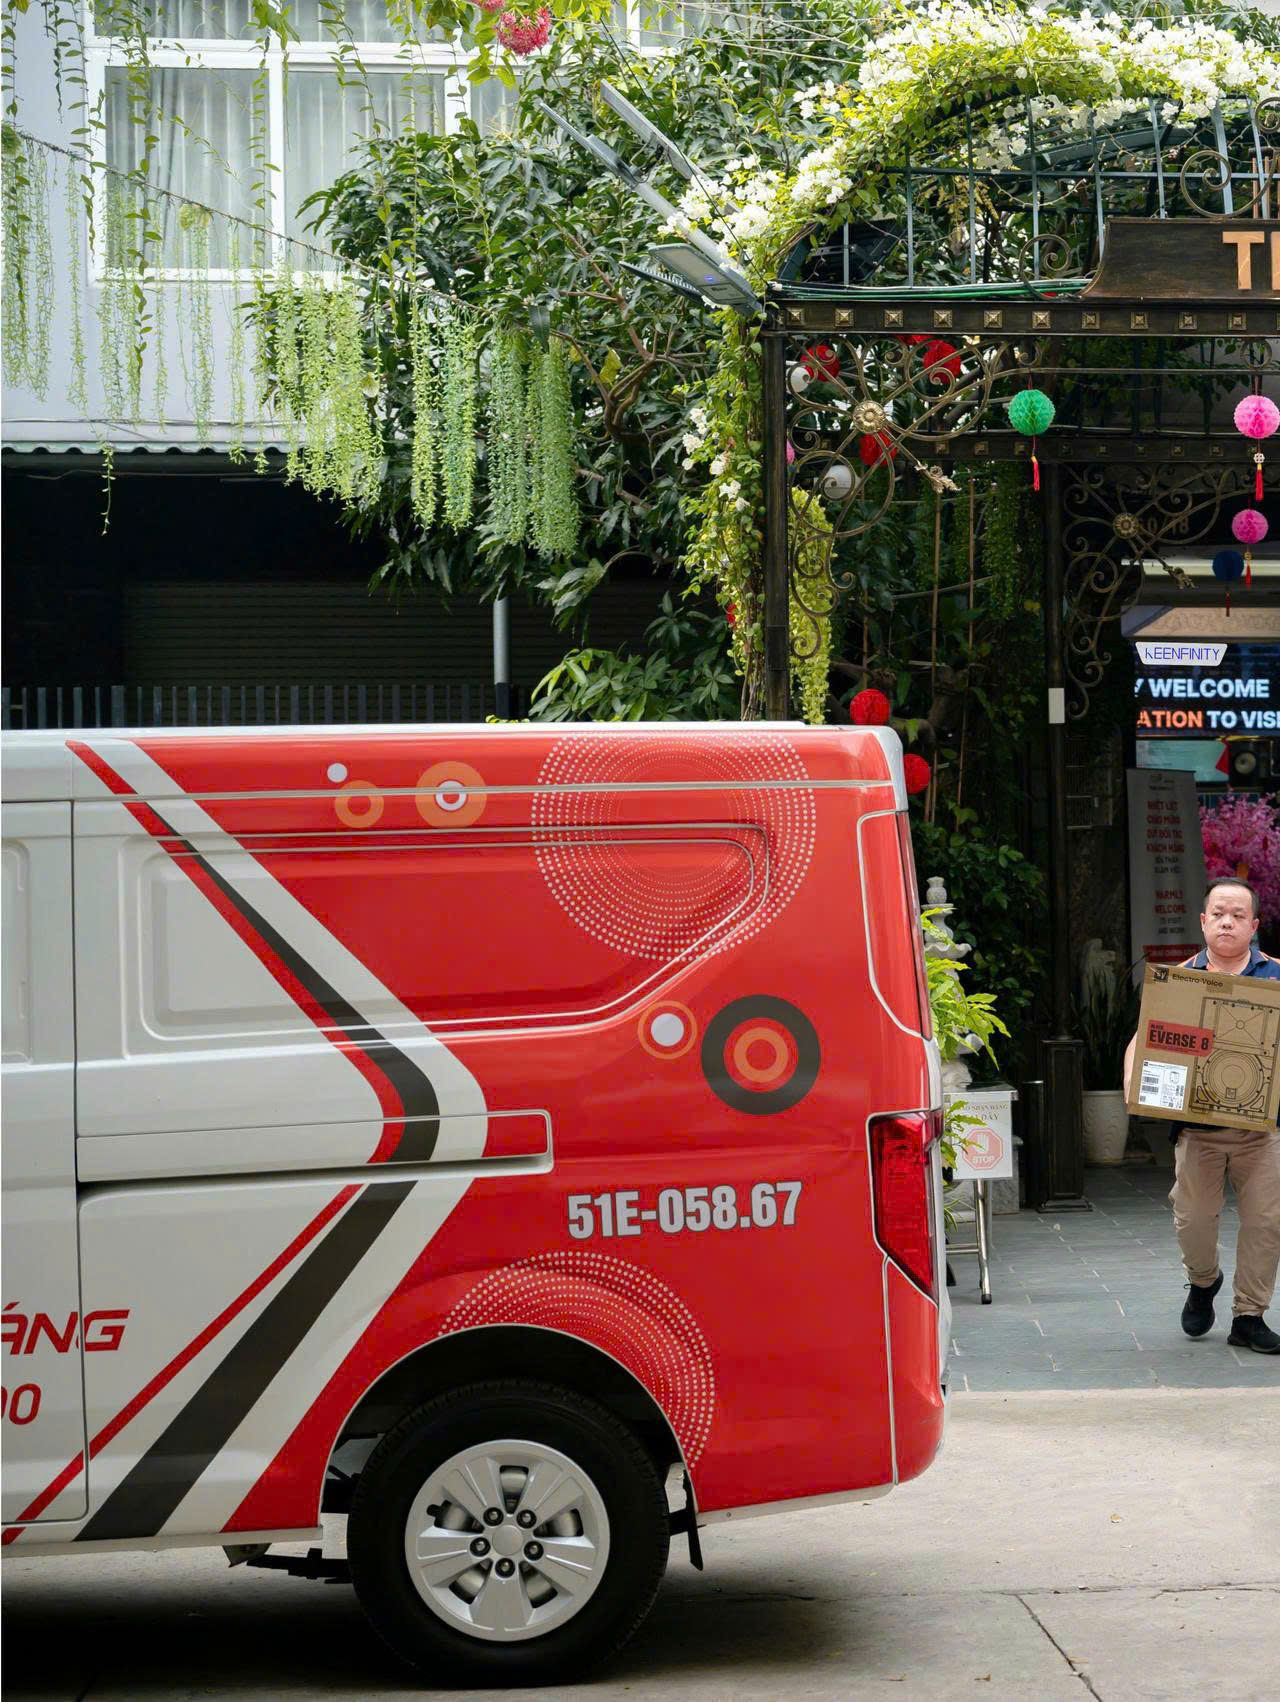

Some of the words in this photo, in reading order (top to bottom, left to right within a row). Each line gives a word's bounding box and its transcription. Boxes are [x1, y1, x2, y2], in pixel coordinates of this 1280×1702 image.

[1145, 647, 1220, 661] KEENFINITY
[1149, 678, 1270, 699] WELCOME
[1206, 710, 1238, 729] TO
[1150, 1029, 1197, 1048] EVERSE
[1201, 1037, 1209, 1050] 8
[567, 1182, 801, 1239] 51E-058.67
